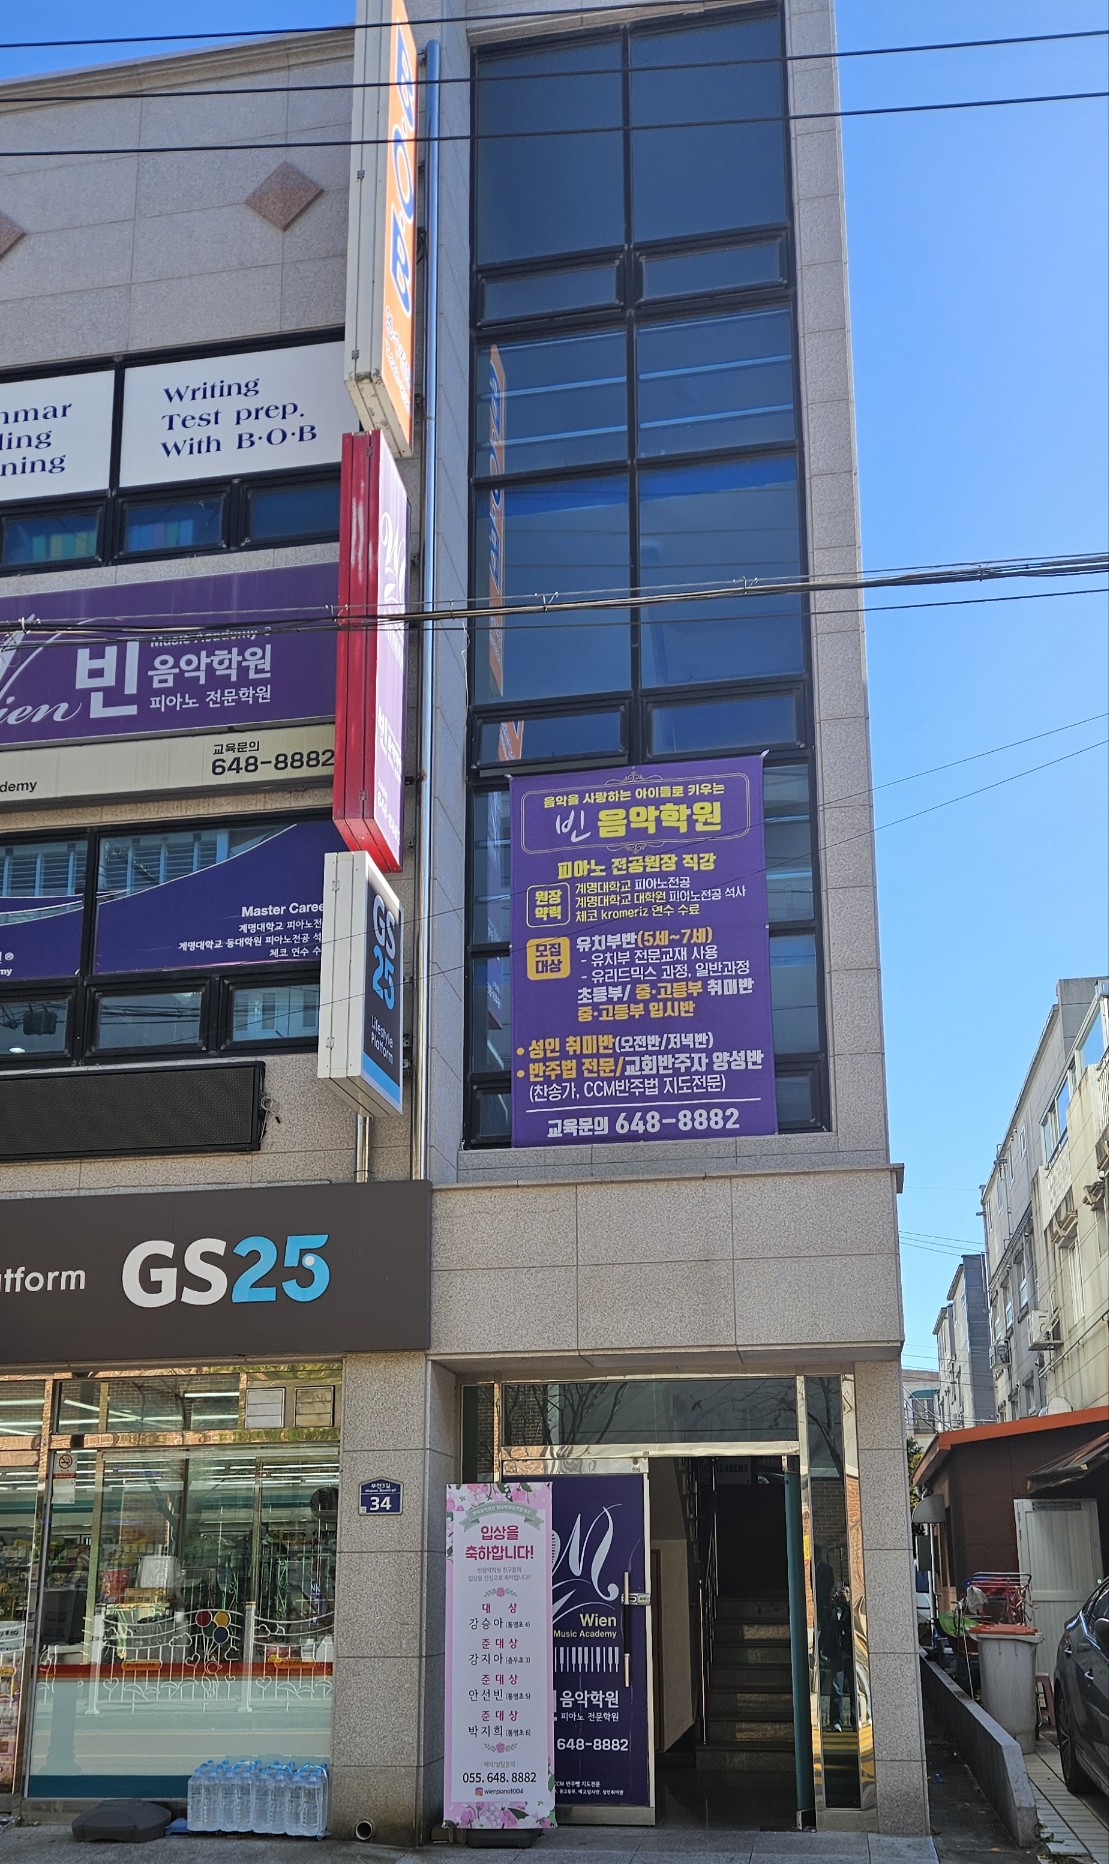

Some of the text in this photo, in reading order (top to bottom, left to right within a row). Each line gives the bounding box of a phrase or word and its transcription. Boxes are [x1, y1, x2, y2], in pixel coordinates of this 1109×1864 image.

[163, 378, 260, 403] Writing
[161, 401, 305, 431] Test prep.
[0, 430, 52, 451] ing
[161, 435, 222, 458] With
[147, 644, 272, 689] 음악학원
[75, 639, 140, 719] 빈
[149, 685, 271, 712] 피아노 전문학원
[213, 741, 259, 755] 교육문의
[211, 749, 334, 775] 648-8882
[544, 783, 725, 808] 음악을 사랑하는 아이들로 키우는
[556, 801, 721, 842] 빈 음악학원
[557, 853, 716, 879] 피아노 전공원장 직강
[575, 877, 690, 894] 계명대학교 피아노전공
[575, 885, 746, 908] 계명대학교 대학원 피아노전공 석사
[535, 890, 562, 905] 원장
[241, 905, 286, 917] Master
[535, 906, 562, 921] 약력
[575, 904, 700, 923] 체코 kromeriz 연수 수료
[239, 918, 321, 933] 계명대학교 피아노전
[178, 940, 223, 951] 계명대학교
[226, 936, 262, 948] 동대학원
[265, 933, 310, 945] 피아노전공
[535, 942, 562, 958] 모집
[576, 927, 713, 952] 유치부반(5세~7세)
[269, 948, 288, 958] 체코
[291, 947, 309, 957] 연수
[591, 944, 718, 967] 유치부 전문교재 사용
[535, 959, 562, 974] 대상
[591, 960, 750, 984] 유리드믹스 과정, 일반과정
[635, 981, 703, 1000] 중·고등부
[707, 978, 754, 996] 취미반
[578, 1000, 695, 1022] 중·고등부 입시반
[529, 1032, 714, 1059] 성인 취미반(오전반/저녁반)
[529, 1049, 765, 1082] 반주법 전문/교회반주자 양성반
[529, 1074, 726, 1103] (찬송가, CCM반주법 지도전문)
[547, 1108, 740, 1138] 교육문의 648-8882
[0, 1234, 331, 1309] tform GS25
[370, 1496, 392, 1511] 34
[481, 1525, 519, 1541] 입상을
[465, 1545, 534, 1561] 축하합니다!
[580, 1614, 617, 1627] Wien
[553, 1630, 617, 1639] Music Academy
[560, 1690, 619, 1708] 음악학원
[561, 1712, 619, 1722] 피아노 전문학원
[557, 1738, 629, 1751] 648-8882
